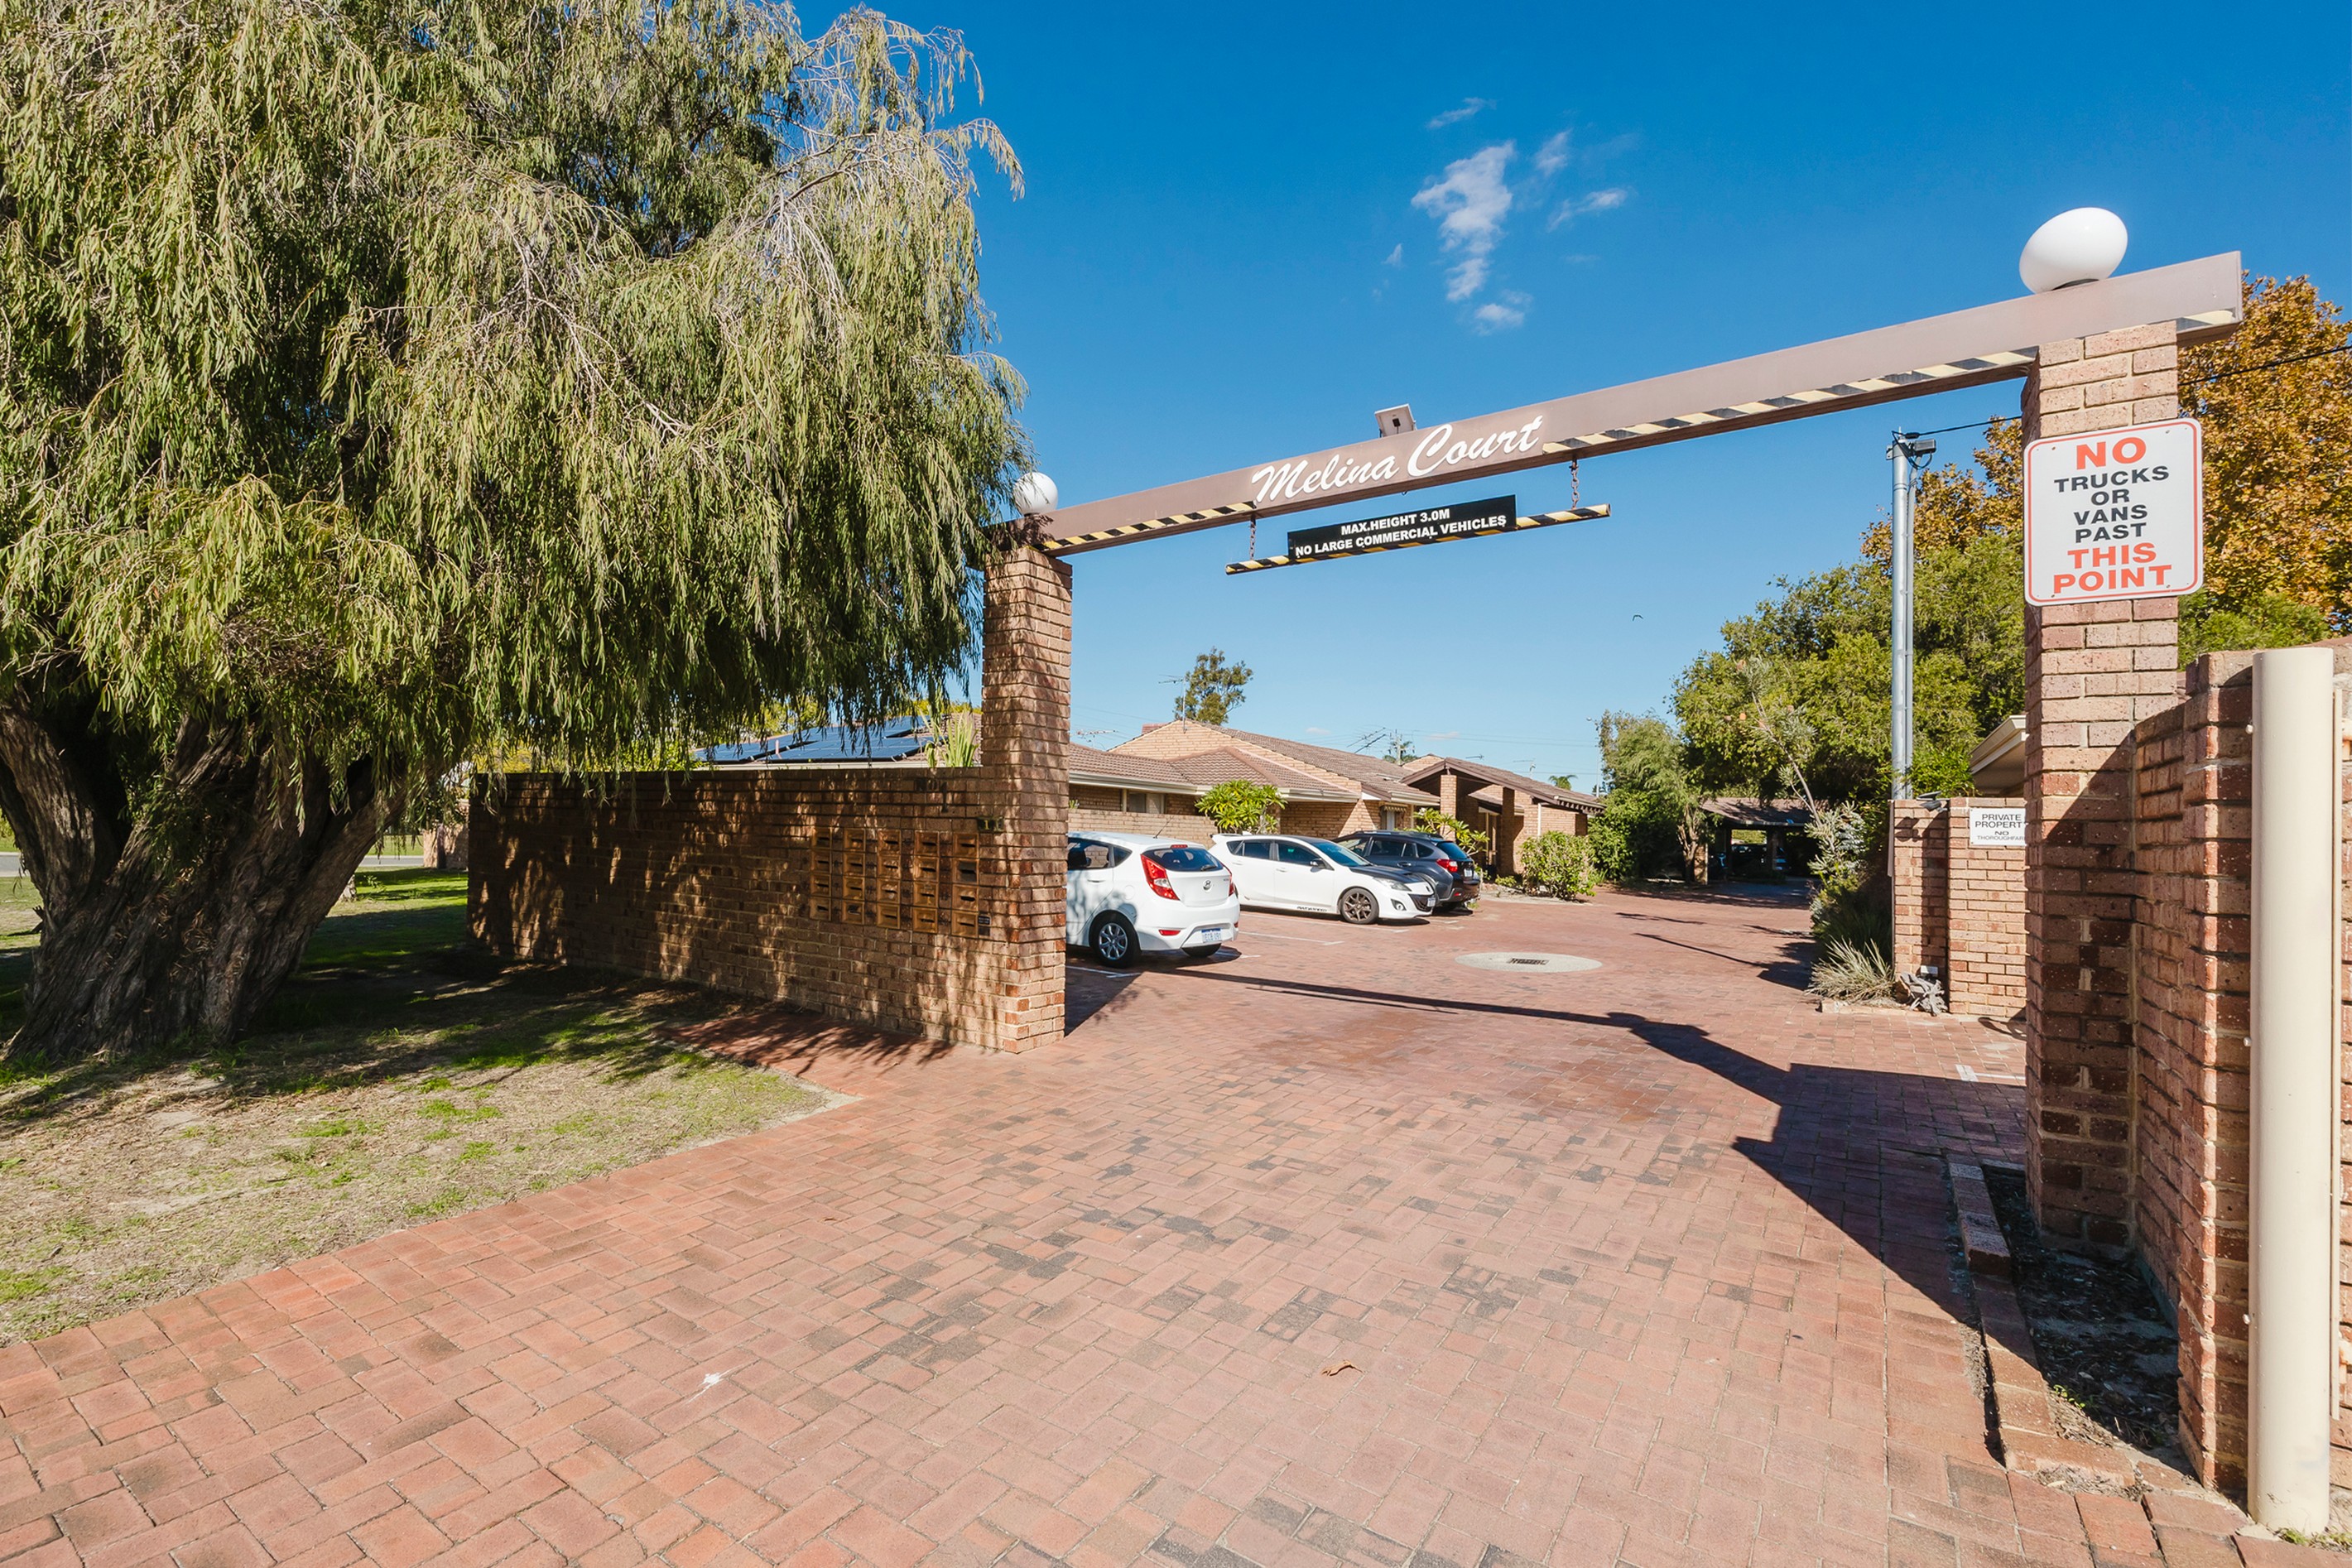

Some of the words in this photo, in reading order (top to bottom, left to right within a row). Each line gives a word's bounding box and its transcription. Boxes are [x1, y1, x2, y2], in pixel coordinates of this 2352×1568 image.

[1252, 455, 1400, 503] Melina
[1407, 415, 1545, 478] Court
[2075, 436, 2147, 470] NO
[2054, 465, 2170, 493] TRUCKS
[2090, 488, 2129, 506] OR
[1340, 512, 1416, 536] MAX.HEIGHT
[1419, 507, 1450, 523] 3.0M
[2073, 504, 2148, 526] VANS
[1295, 545, 1312, 558] NO
[1315, 537, 1354, 555] LARGE
[1355, 525, 1439, 548] COMMERCIAL
[1441, 514, 1507, 535] VEHICLES
[2075, 522, 2147, 543] PAST
[2067, 542, 2157, 570] THIS
[2054, 565, 2172, 594] POINT
